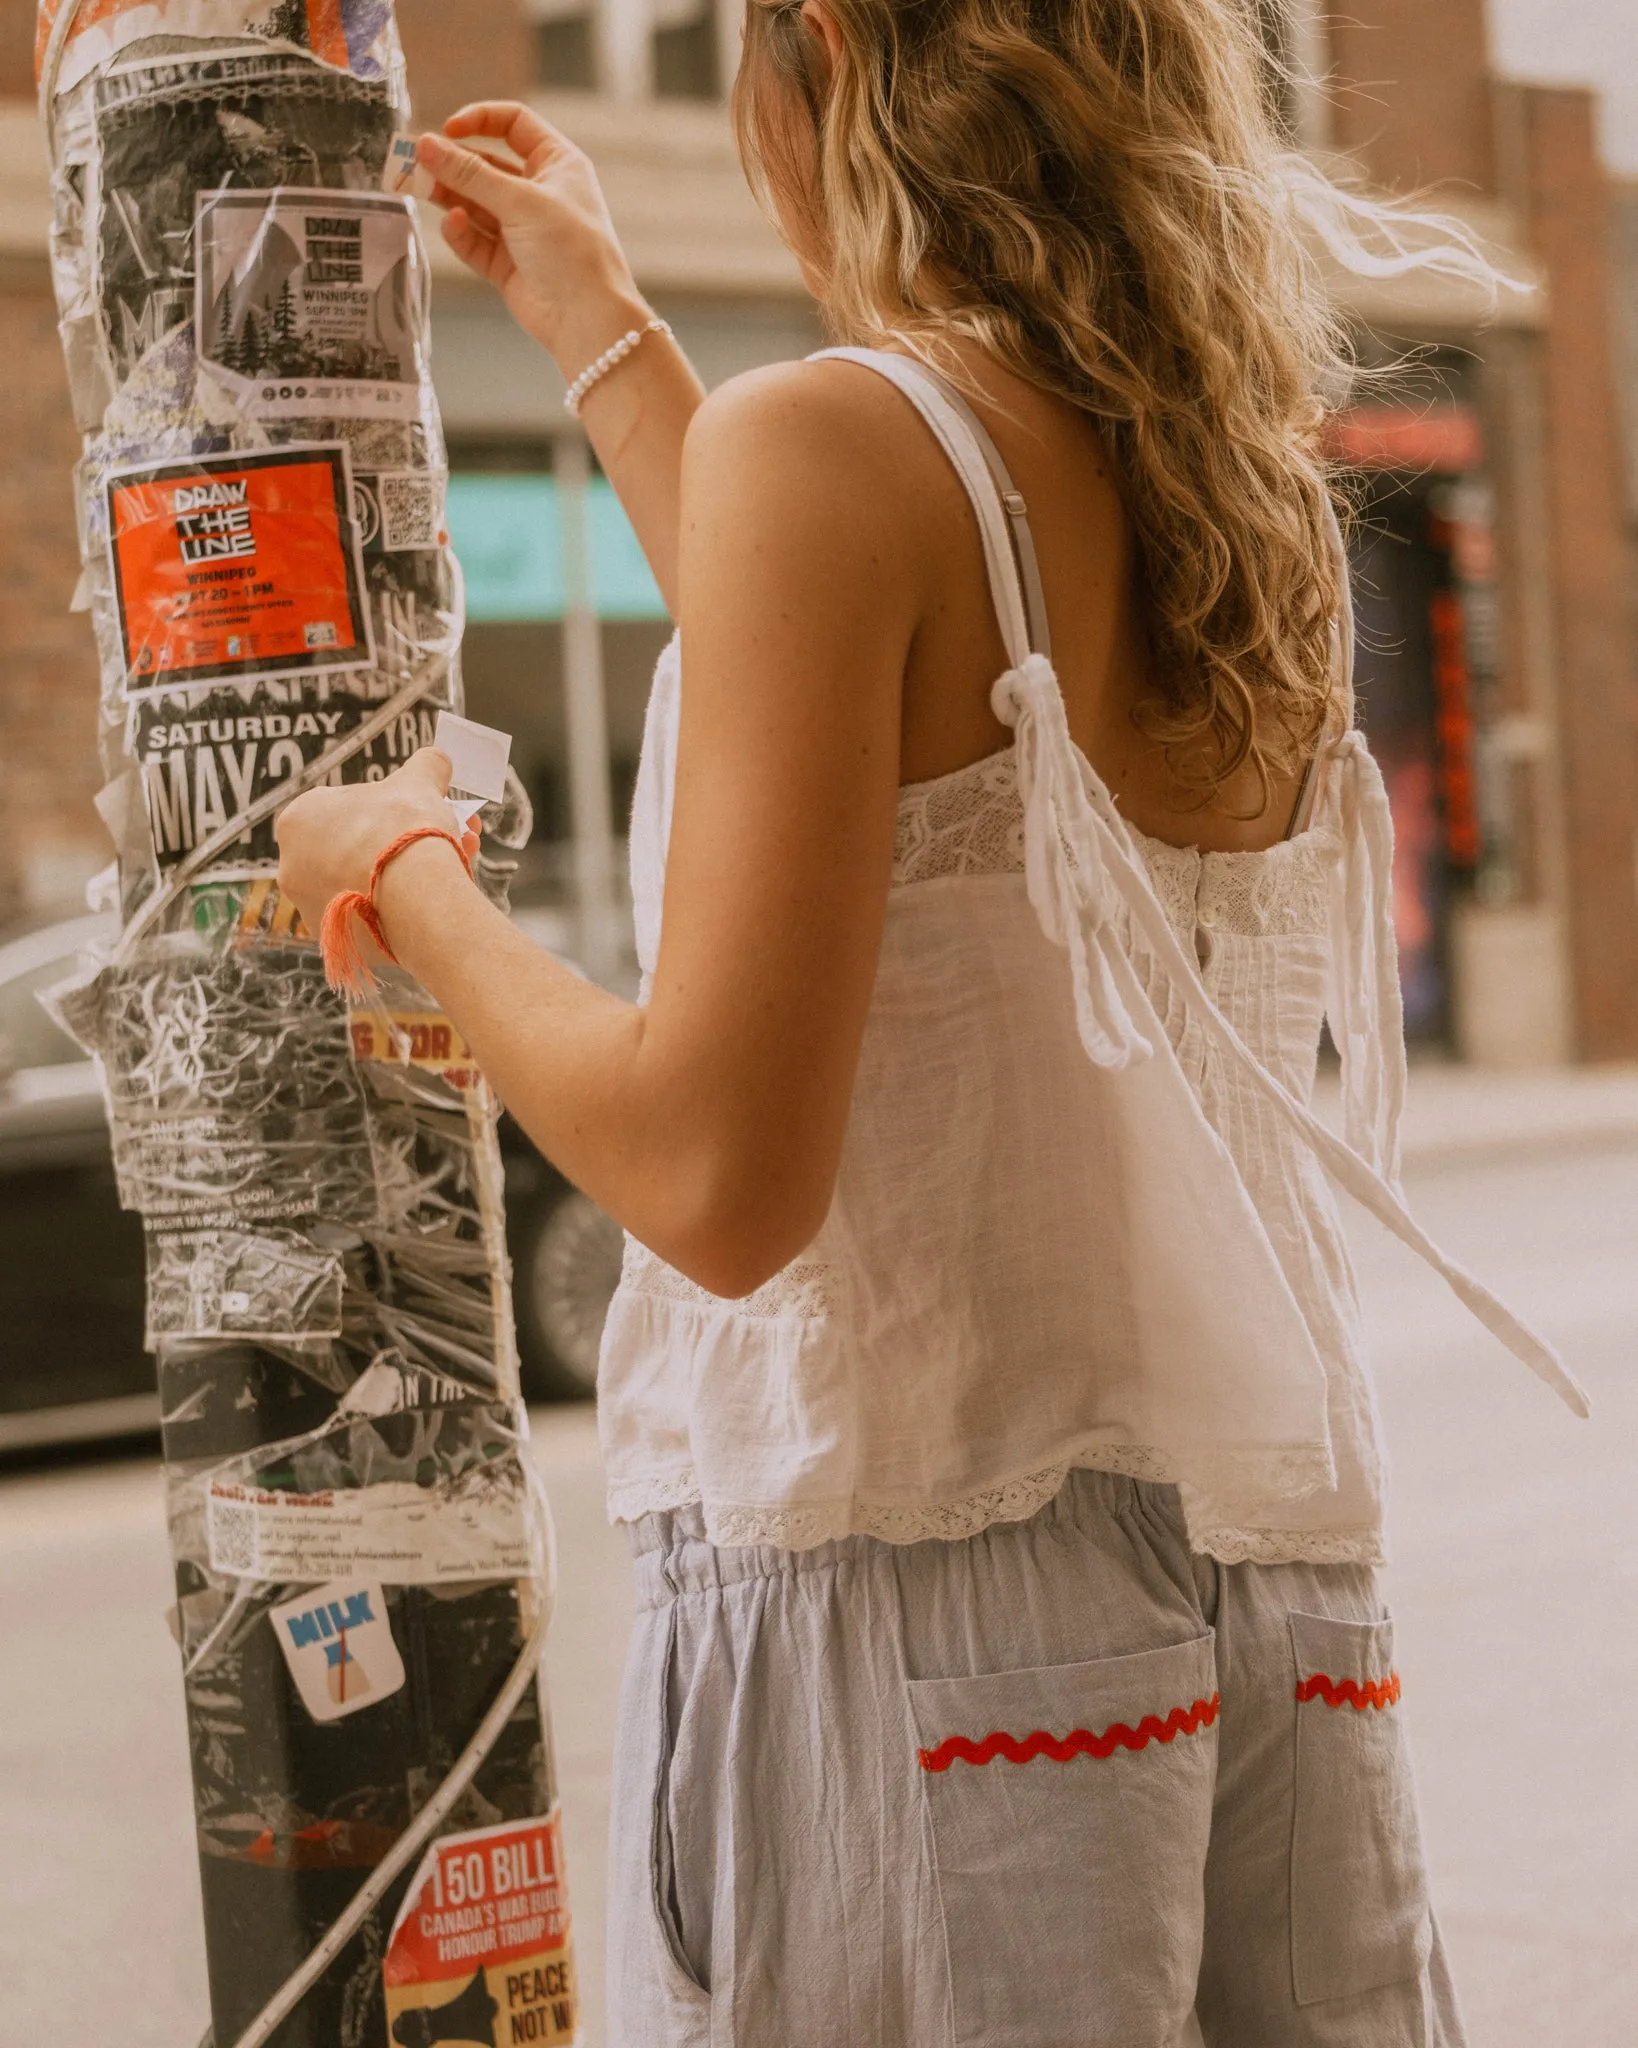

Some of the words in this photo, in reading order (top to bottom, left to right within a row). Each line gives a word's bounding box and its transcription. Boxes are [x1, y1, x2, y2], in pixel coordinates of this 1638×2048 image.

[306, 240, 362, 260] THE
[307, 262, 363, 282] LINE
[303, 289, 369, 304] WINNIPEG
[174, 478, 247, 513] DRAW
[176, 506, 250, 537] THE
[180, 532, 257, 565] LINE
[186, 566, 257, 585] WINNIPEG
[211, 587, 228, 600] 20
[149, 711, 344, 749] SATURDAY
[146, 741, 259, 852] MAY
[286, 1590, 376, 1651] MILK
[420, 1902, 496, 1937] CANADA'S
[498, 1896, 530, 1921] WAR
[438, 1930, 499, 1962] HONOUR
[500, 1916, 545, 1948] TRUMP
[506, 1961, 569, 2007] PEACE
[511, 2005, 549, 2045] NOT
